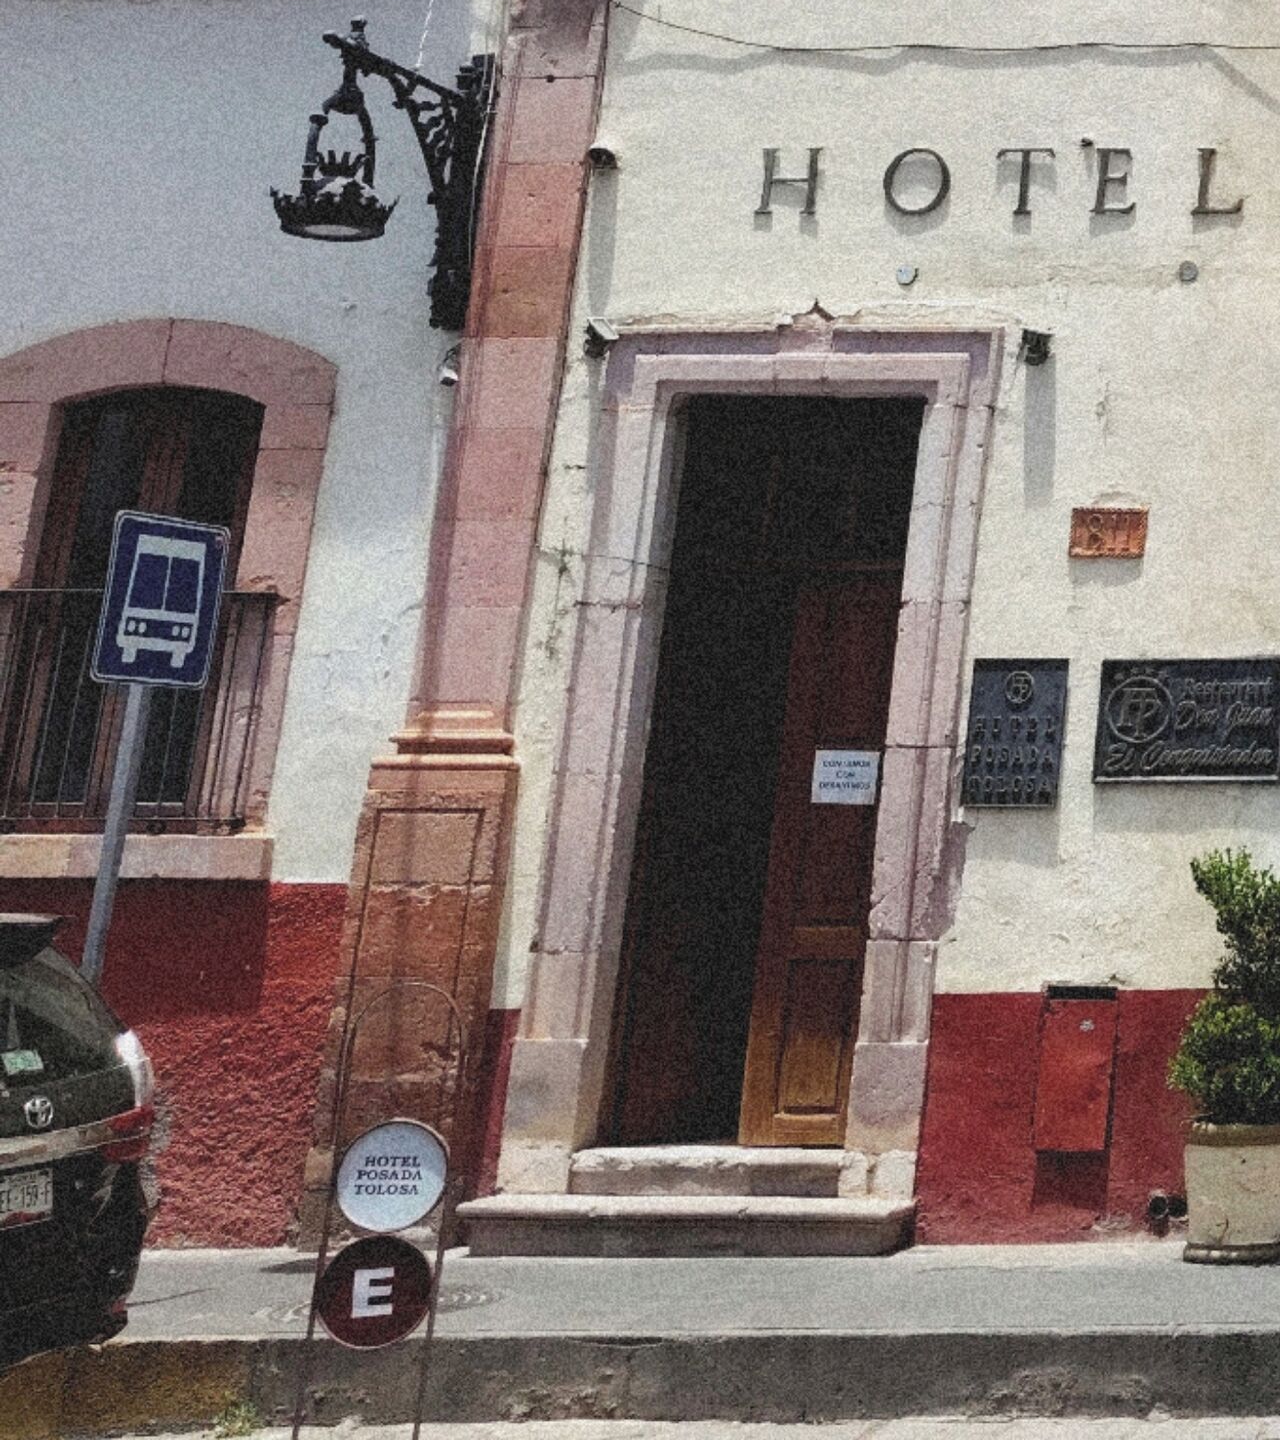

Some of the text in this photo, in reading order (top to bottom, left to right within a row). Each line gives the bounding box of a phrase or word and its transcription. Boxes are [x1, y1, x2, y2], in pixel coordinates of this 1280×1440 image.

[753, 147, 1245, 215] HOTEL
[364, 1156, 421, 1168] HOTEL
[356, 1169, 423, 1180] POSADA
[354, 1184, 419, 1196] TOLOSA
[351, 1267, 395, 1319] E
